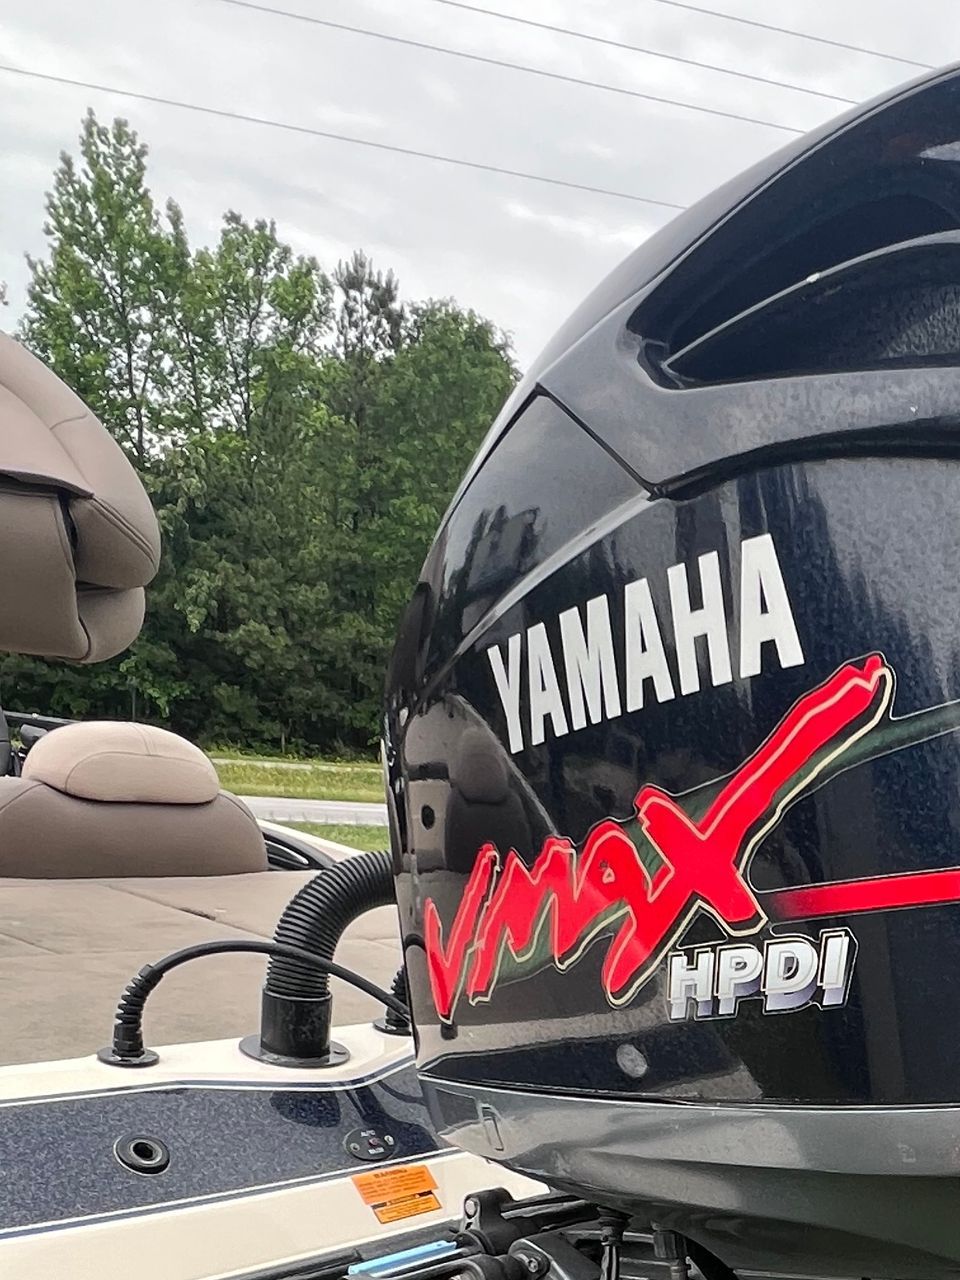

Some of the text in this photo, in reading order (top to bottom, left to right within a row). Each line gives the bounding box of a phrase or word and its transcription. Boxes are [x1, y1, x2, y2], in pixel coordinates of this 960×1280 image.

[487, 533, 805, 754] YAMAHA
[424, 653, 895, 1024] VMAX
[668, 927, 853, 1022] HPDI
